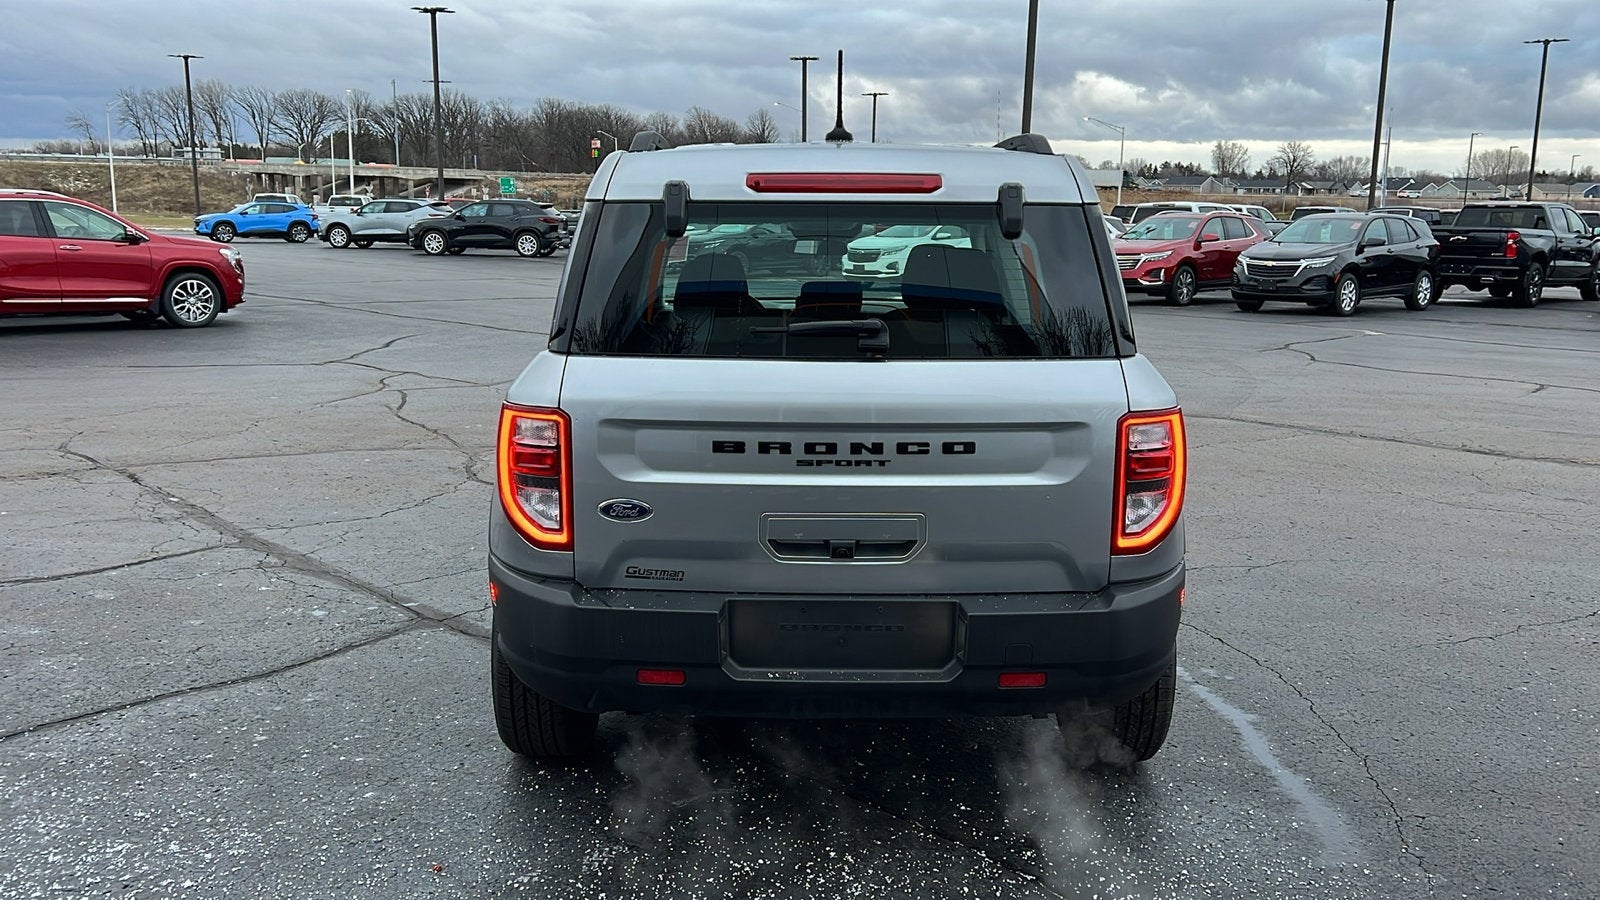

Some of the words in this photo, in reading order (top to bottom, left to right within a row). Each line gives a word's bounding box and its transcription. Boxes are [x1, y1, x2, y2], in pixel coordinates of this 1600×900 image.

[712, 440, 976, 455] BRONCO
[796, 459, 891, 467] SPORT
[609, 503, 640, 517] Ford
[778, 623, 905, 632] BRONCO
